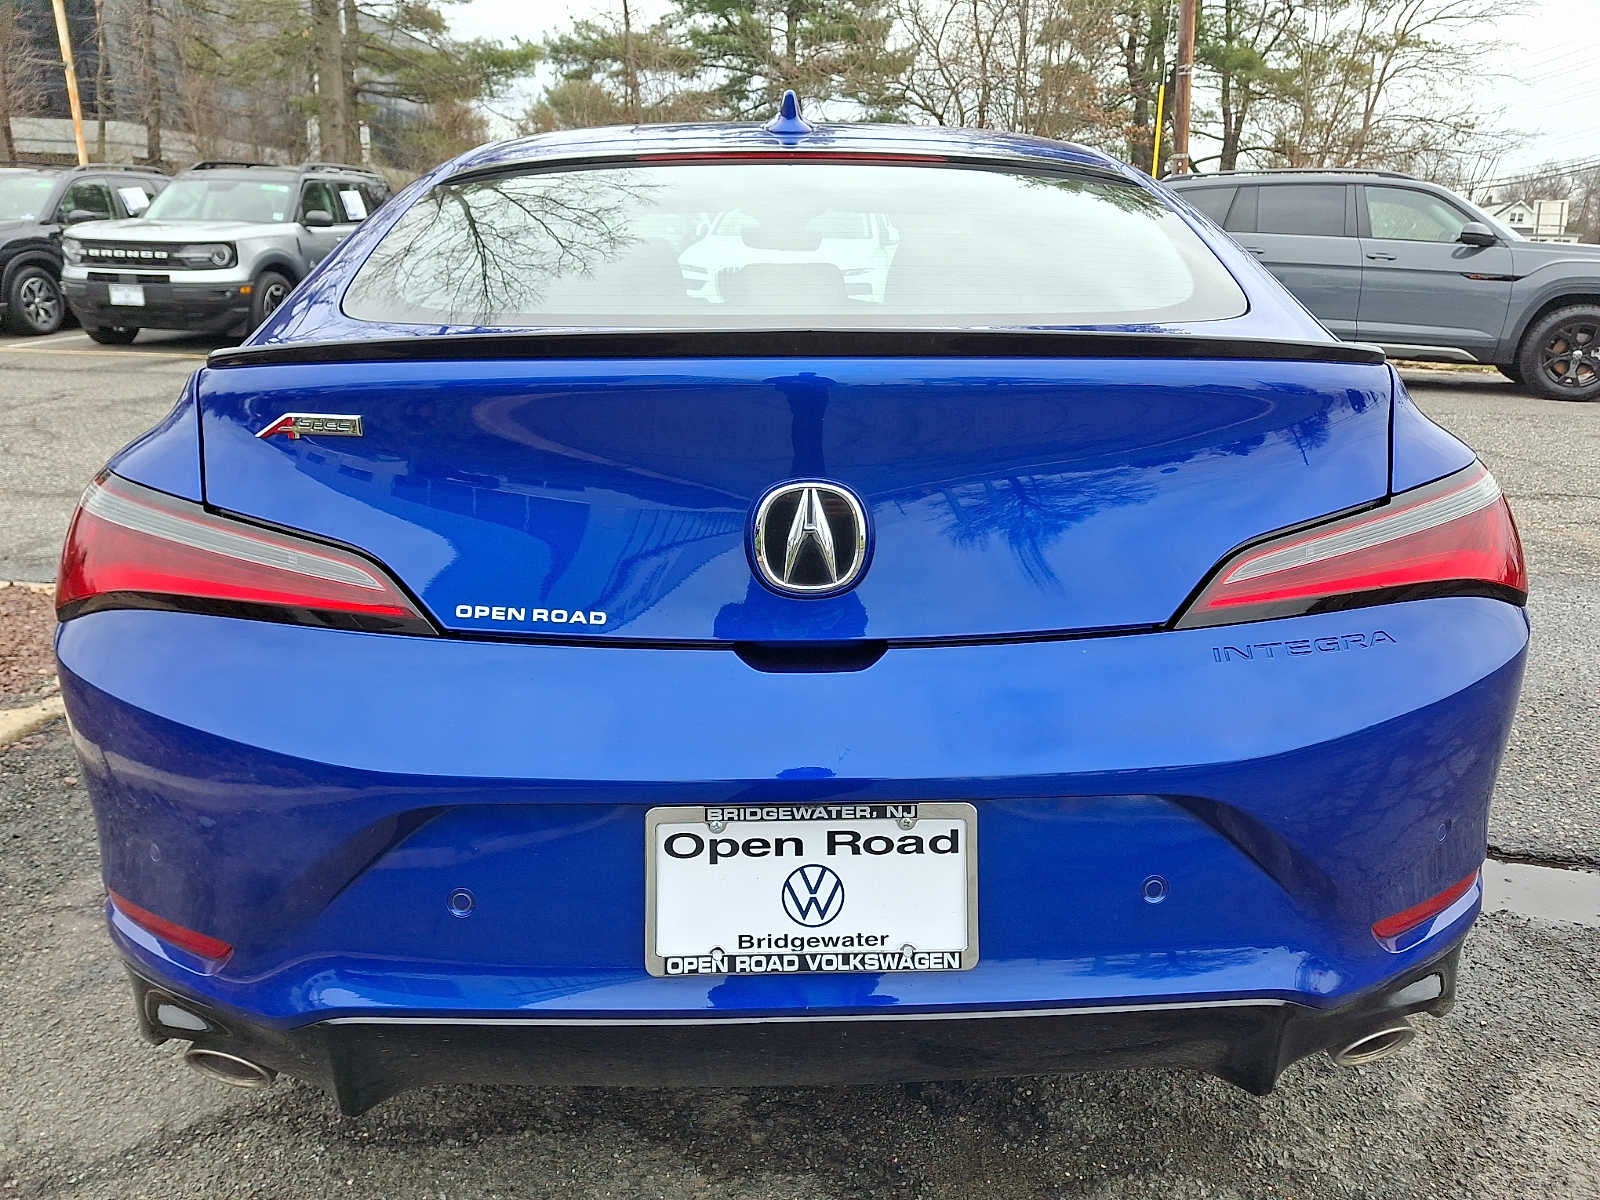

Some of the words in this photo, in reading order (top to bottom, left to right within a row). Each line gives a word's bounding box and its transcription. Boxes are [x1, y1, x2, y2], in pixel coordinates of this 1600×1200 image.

[455, 604, 526, 621] OPEN
[532, 608, 607, 625] ROAD
[1212, 629, 1397, 663] INTEGRA
[886, 804, 917, 818] NJ
[663, 833, 804, 864] Open
[826, 829, 960, 855] Road
[737, 932, 889, 951] Bridgewater
[666, 955, 729, 973] OPEN
[735, 954, 799, 973] ROAD
[805, 952, 961, 971] VOLKSWAGEN
